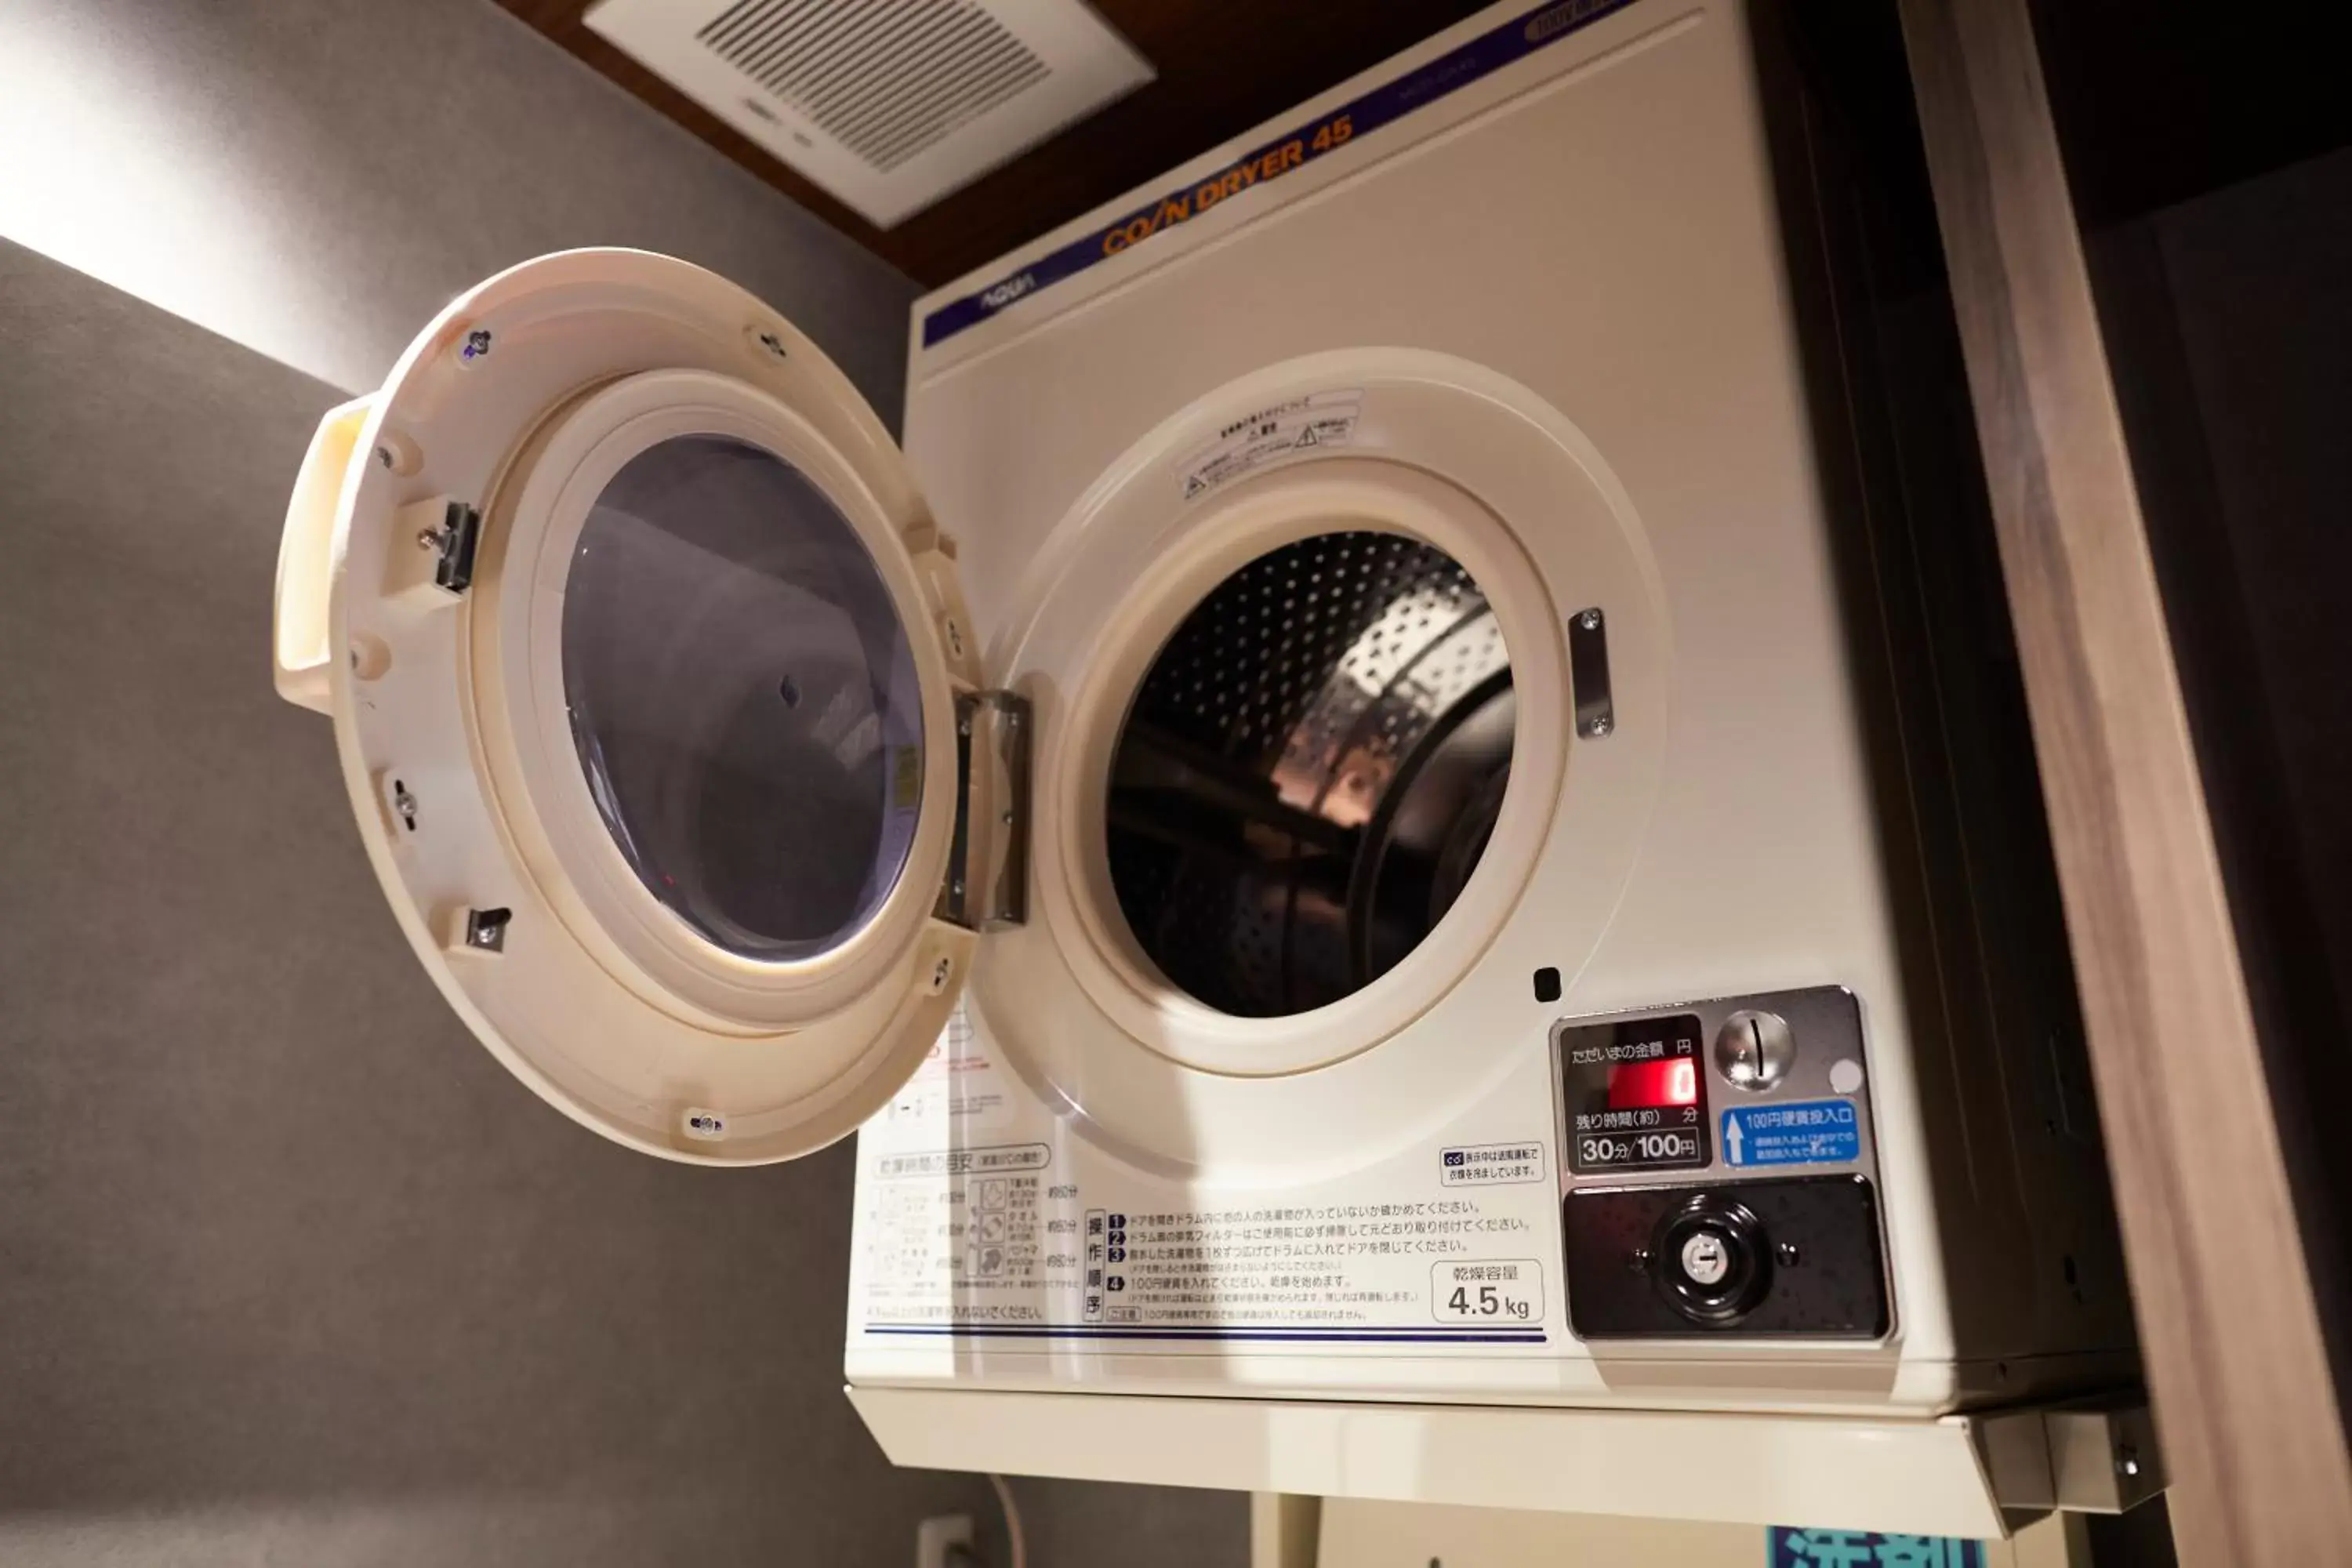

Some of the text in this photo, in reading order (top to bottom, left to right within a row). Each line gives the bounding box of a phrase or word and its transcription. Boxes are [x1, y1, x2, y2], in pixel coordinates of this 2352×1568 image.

[1196, 140, 1303, 210] DRYER
[1312, 114, 1352, 151] 45
[1572, 1039, 1693, 1064] ただいまの金額 円
[1577, 1106, 1699, 1131] 残り時間(約) 分
[1747, 1108, 1853, 1129] 100円硬貨投入口
[1583, 1134, 1695, 1161] 30分/100円
[1087, 1218, 1104, 1313] 操作順序
[1453, 1265, 1519, 1281] 乾燥容量
[1448, 1286, 1530, 1319] 4.5 kg
